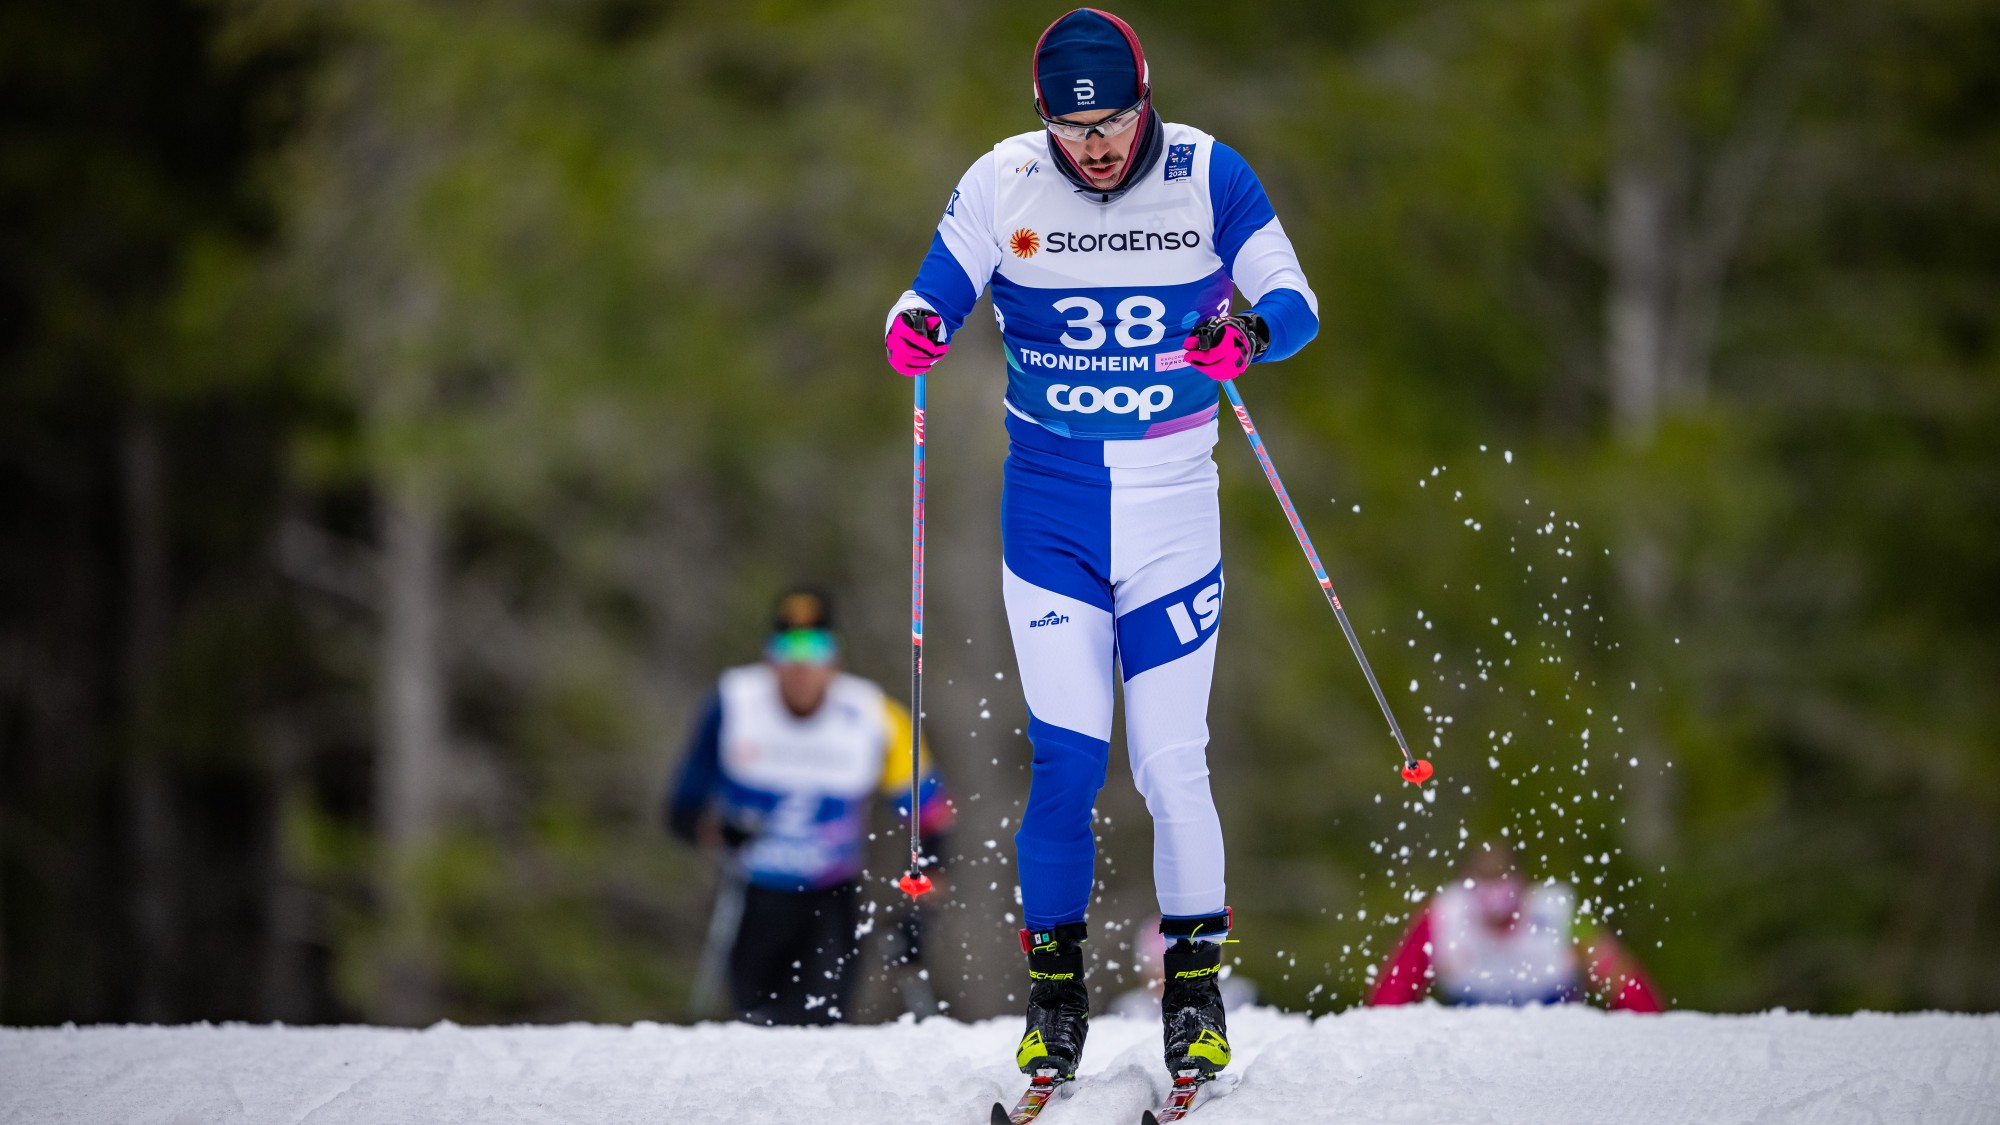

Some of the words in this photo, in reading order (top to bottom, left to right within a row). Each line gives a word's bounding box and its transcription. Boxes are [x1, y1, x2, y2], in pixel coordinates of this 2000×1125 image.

[1046, 230, 1200, 253] StoraEnso
[1052, 295, 1166, 350] 38
[1020, 347, 1149, 371] TRONDHEIM
[1046, 383, 1174, 421] coop
[1165, 582, 1222, 646] IS
[1174, 963, 1221, 979] FISCHE
